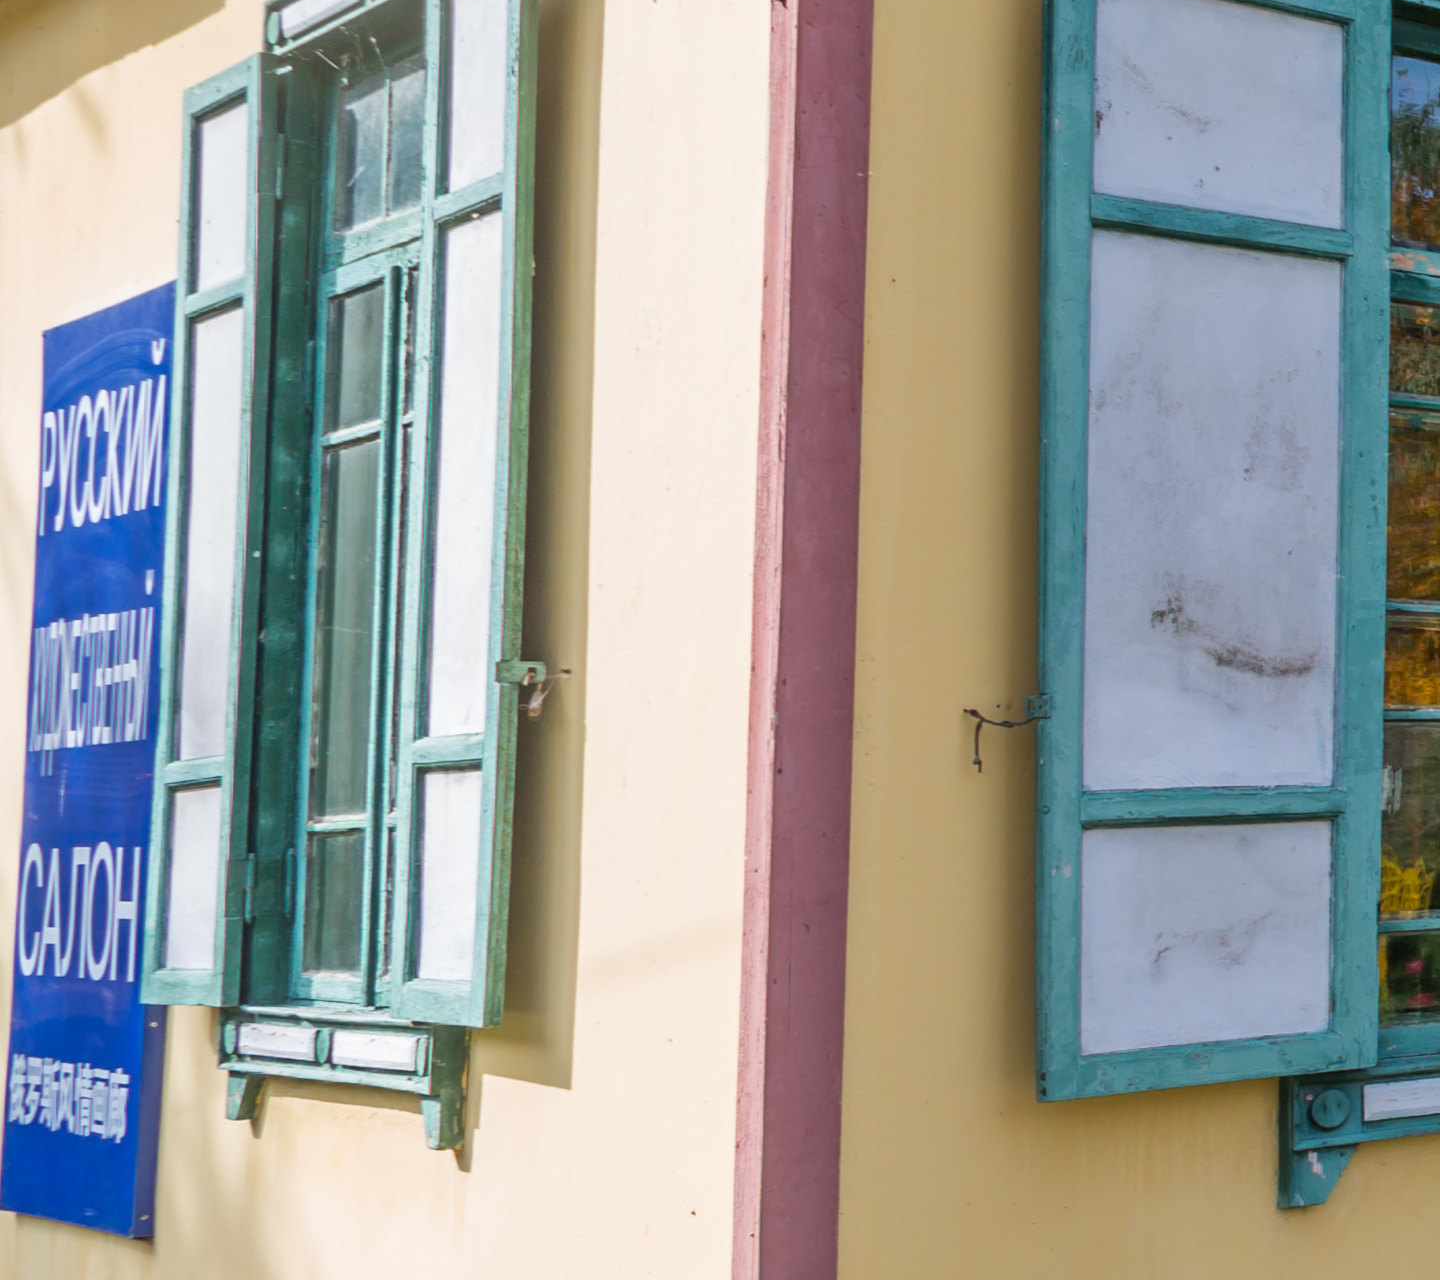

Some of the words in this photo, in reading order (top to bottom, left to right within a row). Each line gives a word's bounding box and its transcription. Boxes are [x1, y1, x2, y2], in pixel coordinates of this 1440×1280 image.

[39, 338, 166, 536] РУССКИЙ
[19, 841, 142, 982] САЛОН
[8, 1053, 131, 1144] 俄罗斯风情画廊
